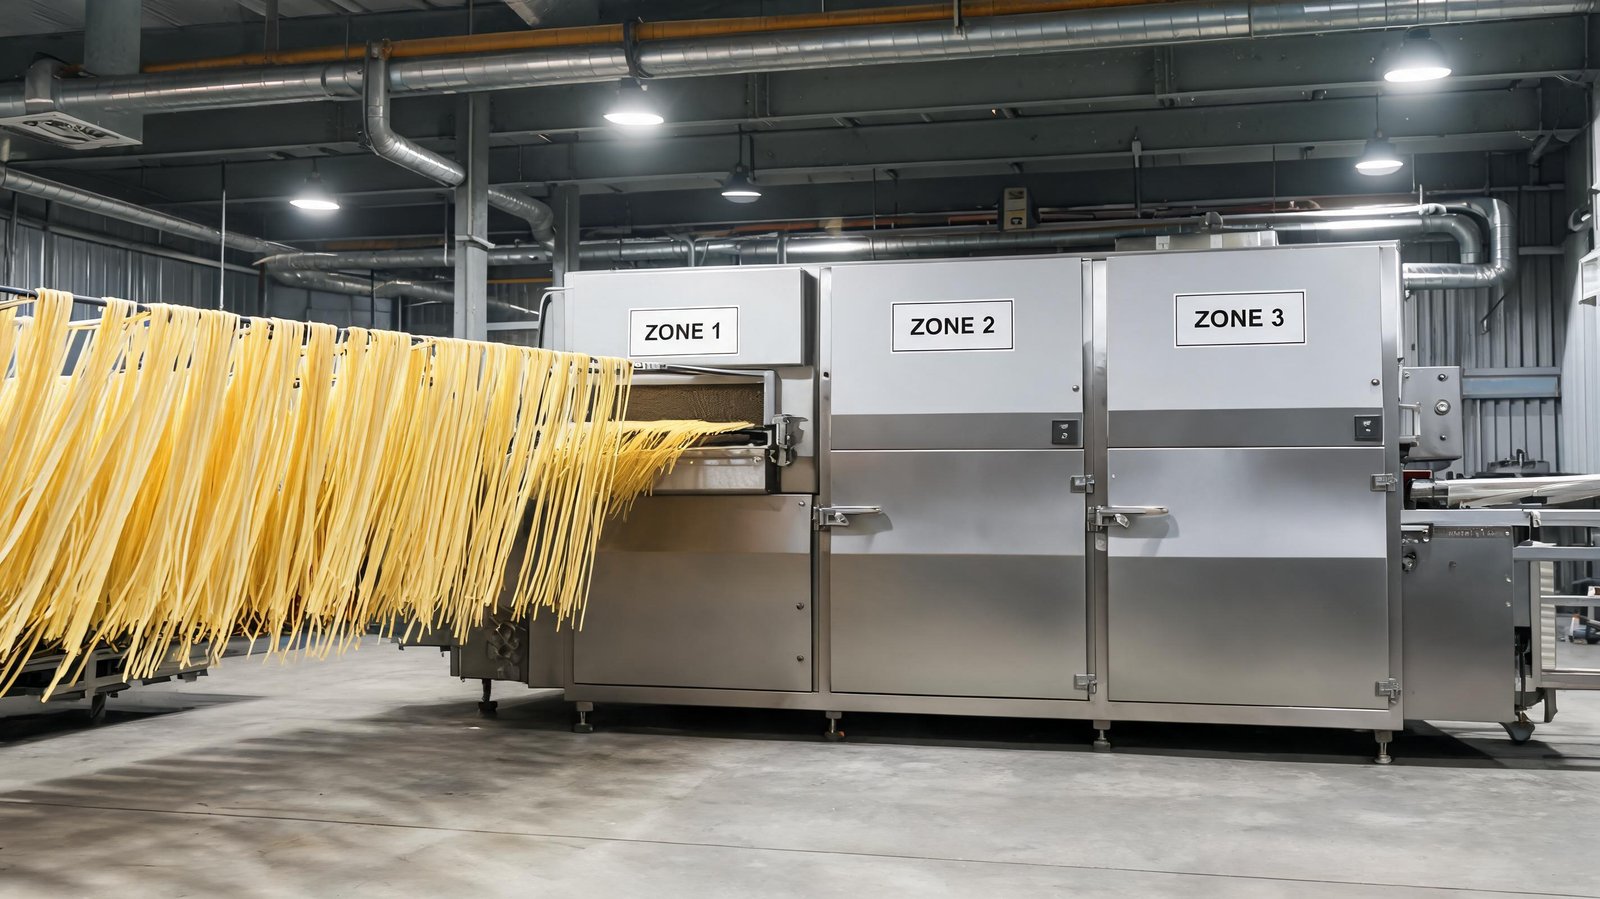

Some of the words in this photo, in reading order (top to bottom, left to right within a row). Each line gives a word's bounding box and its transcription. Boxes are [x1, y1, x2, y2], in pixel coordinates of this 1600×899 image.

[911, 317, 974, 335] ZONE
[983, 316, 994, 333] 2
[1195, 309, 1263, 328] ZONE
[1272, 309, 1284, 326] 3
[645, 323, 703, 340] ZONE
[712, 322, 720, 340] 1
